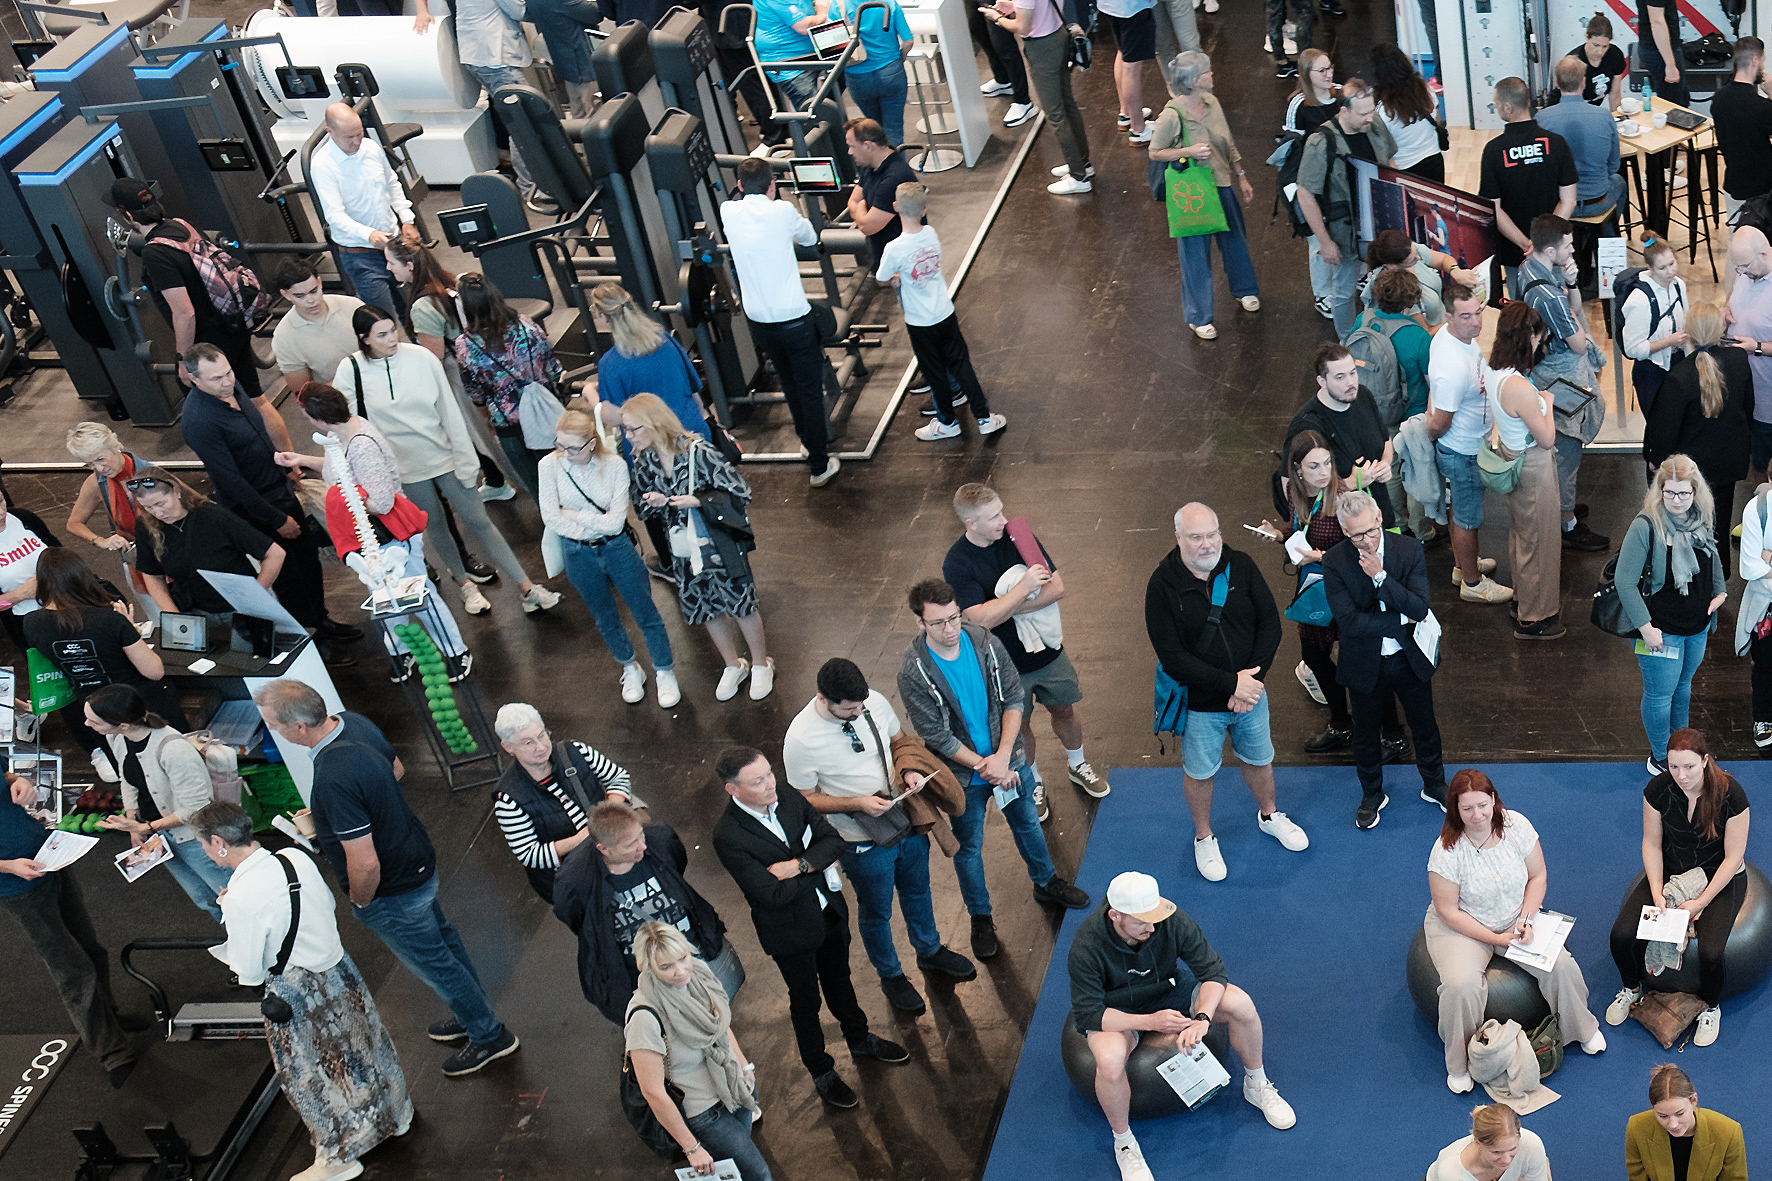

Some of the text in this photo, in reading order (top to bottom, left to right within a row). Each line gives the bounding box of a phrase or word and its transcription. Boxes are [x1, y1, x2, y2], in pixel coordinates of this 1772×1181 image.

[1509, 143, 1544, 160] CUBE
[0, 536, 41, 568] Smile
[0, 1085, 34, 1135] SPINE
